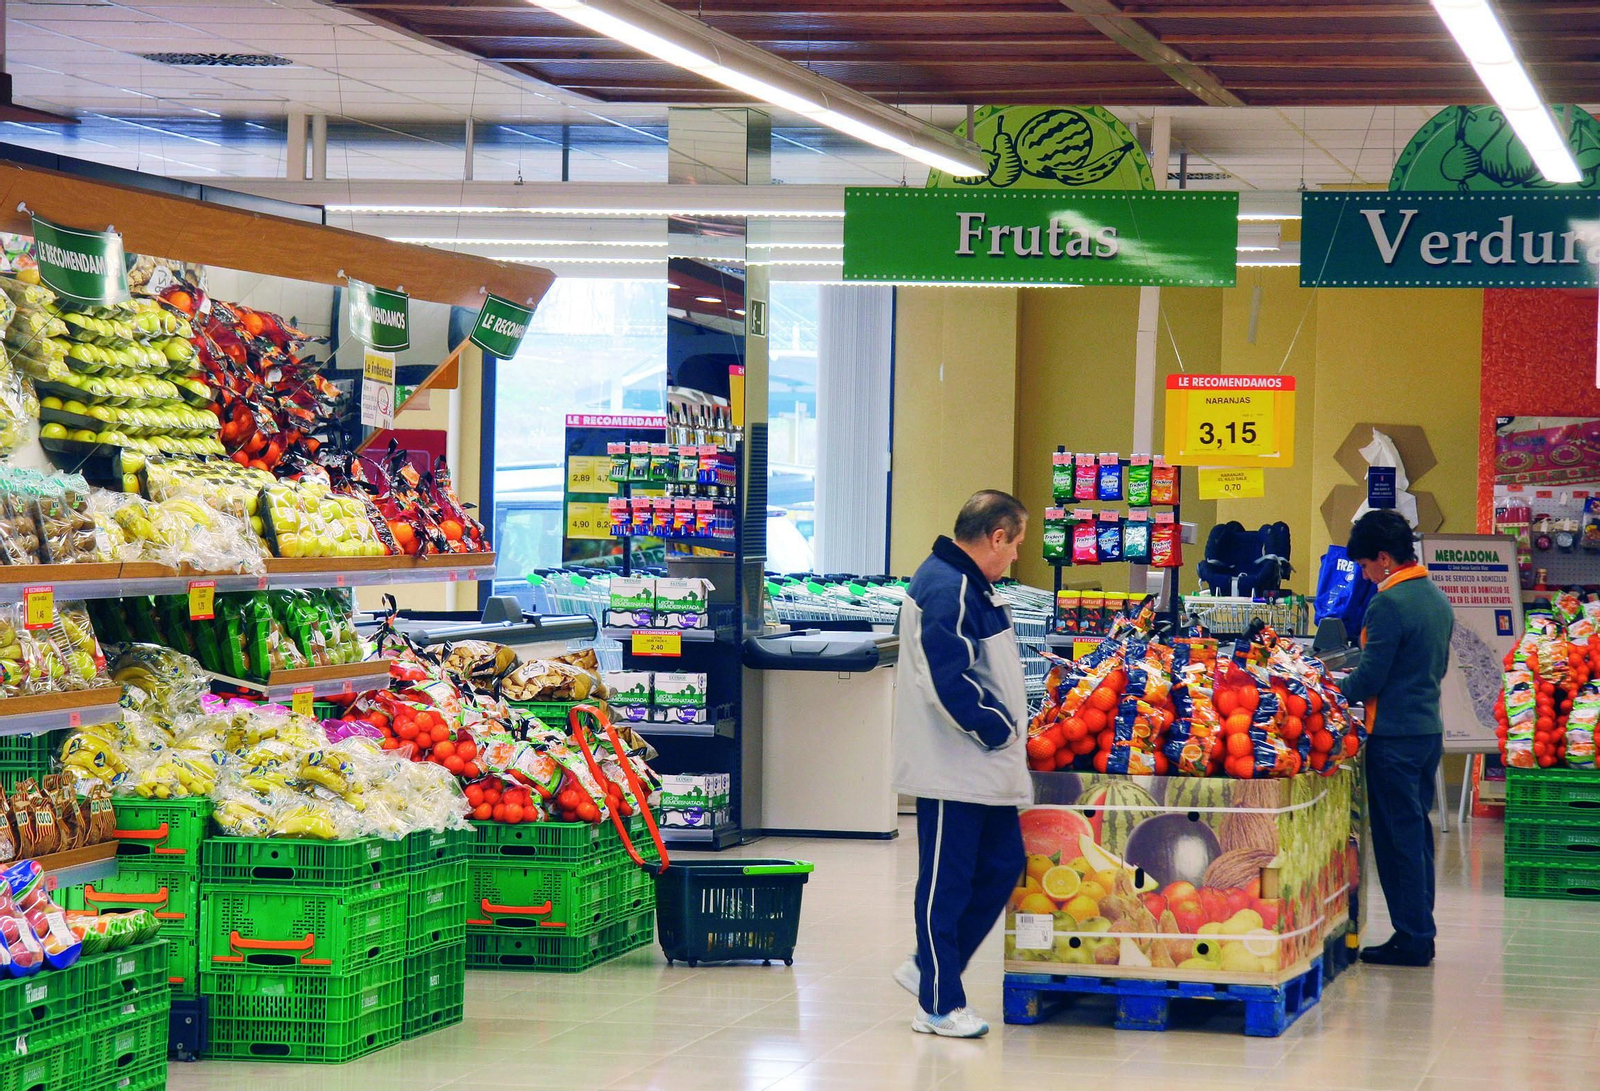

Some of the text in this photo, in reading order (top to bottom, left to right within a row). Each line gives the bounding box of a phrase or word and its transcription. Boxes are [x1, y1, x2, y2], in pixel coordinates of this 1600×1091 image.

[955, 211, 1119, 258] Frutas
[37, 240, 118, 276] LE RECOMENDAM
[481, 312, 496, 330] LE
[371, 361, 393, 379] interesa
[1178, 377, 1282, 388] LE RECOMENDAMOS
[1205, 396, 1251, 404] NARANJAS
[567, 415, 579, 425] LE
[1199, 421, 1257, 449] 3,15
[573, 474, 590, 482] 2,89
[597, 474, 610, 482] 4,7
[1224, 483, 1241, 492] 0,70
[572, 520, 590, 529] 4,90
[1152, 540, 1171, 548] Trident
[1435, 549, 1500, 562] MERCADONA
[1432, 573, 1443, 582] ÁREA
[1481, 575, 1508, 583] DOMICILIO
[1478, 586, 1503, 594] DOMICILIO
[1504, 586, 1510, 594] SE
[1457, 596, 1464, 604] EN
[1464, 596, 1470, 604] EL
[1471, 594, 1483, 604] ÁREA
[1483, 596, 1490, 604] DE
[36, 811, 52, 824] COCO
